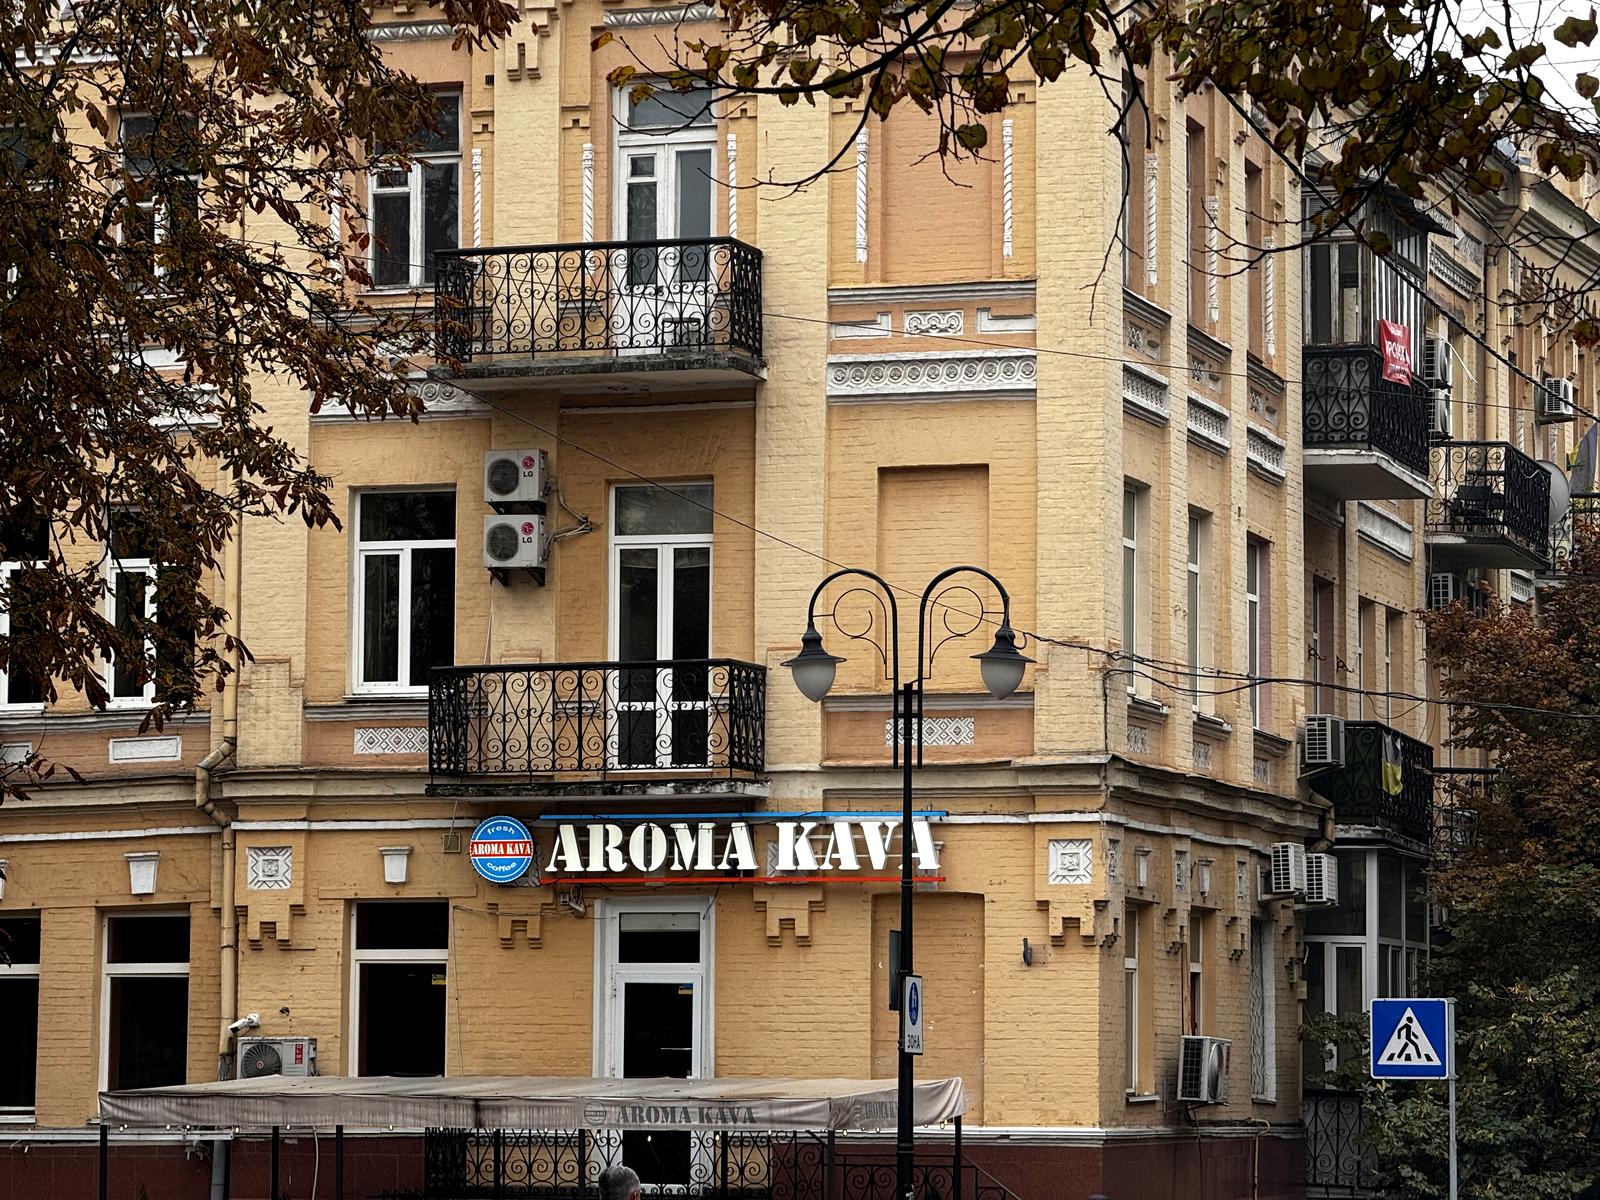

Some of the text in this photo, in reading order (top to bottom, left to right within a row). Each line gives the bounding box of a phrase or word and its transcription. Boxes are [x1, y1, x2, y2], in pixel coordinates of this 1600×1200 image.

[523, 470, 534, 478] LG
[522, 536, 533, 544] LG
[487, 825, 515, 835] fresh
[472, 843, 531, 855] AROMA KAVA
[544, 821, 942, 872] AROMA KAVA
[486, 861, 517, 872] coffee
[616, 1105, 692, 1124] AROMA
[698, 1106, 758, 1125] KAVA
